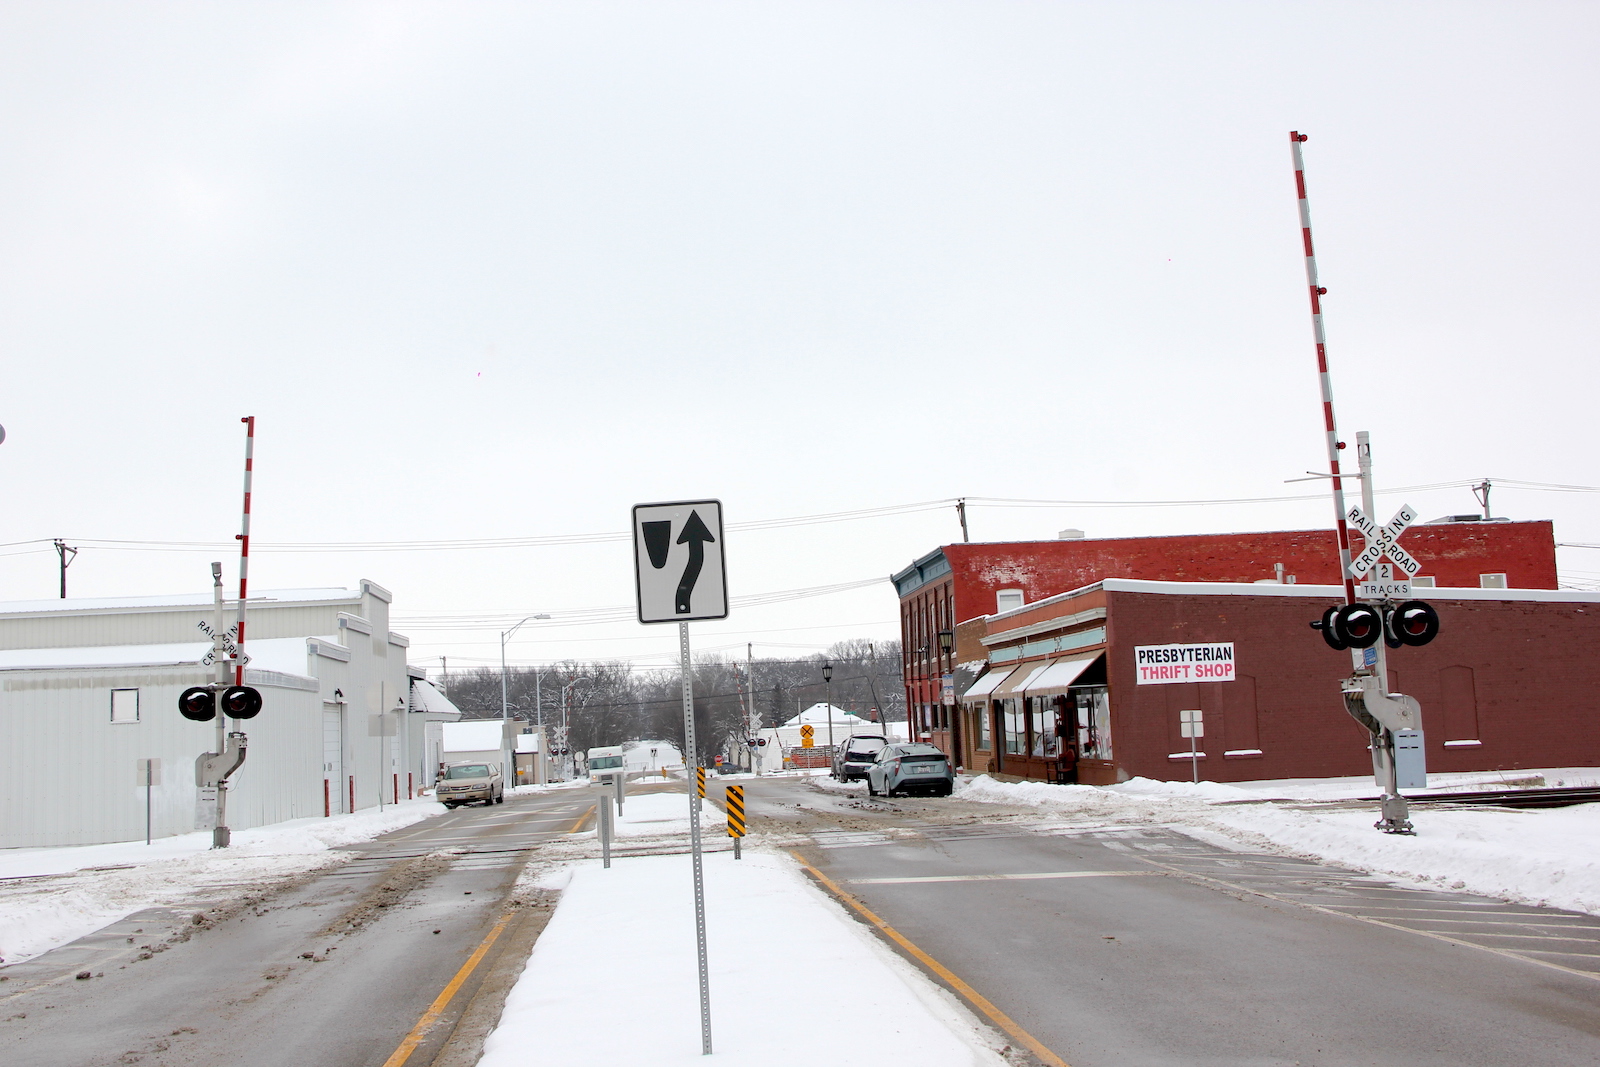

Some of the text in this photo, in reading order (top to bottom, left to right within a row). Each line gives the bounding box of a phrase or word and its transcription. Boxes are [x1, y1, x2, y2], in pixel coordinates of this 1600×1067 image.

[1348, 508, 1417, 573] RAIL ROAD
[1355, 511, 1411, 572] CROSSING
[1380, 566, 1389, 578] 2
[1364, 584, 1408, 594] TRACKS
[1138, 646, 1232, 664] PRESBYTERIAN
[1140, 663, 1233, 680] THRIFT SHOP
